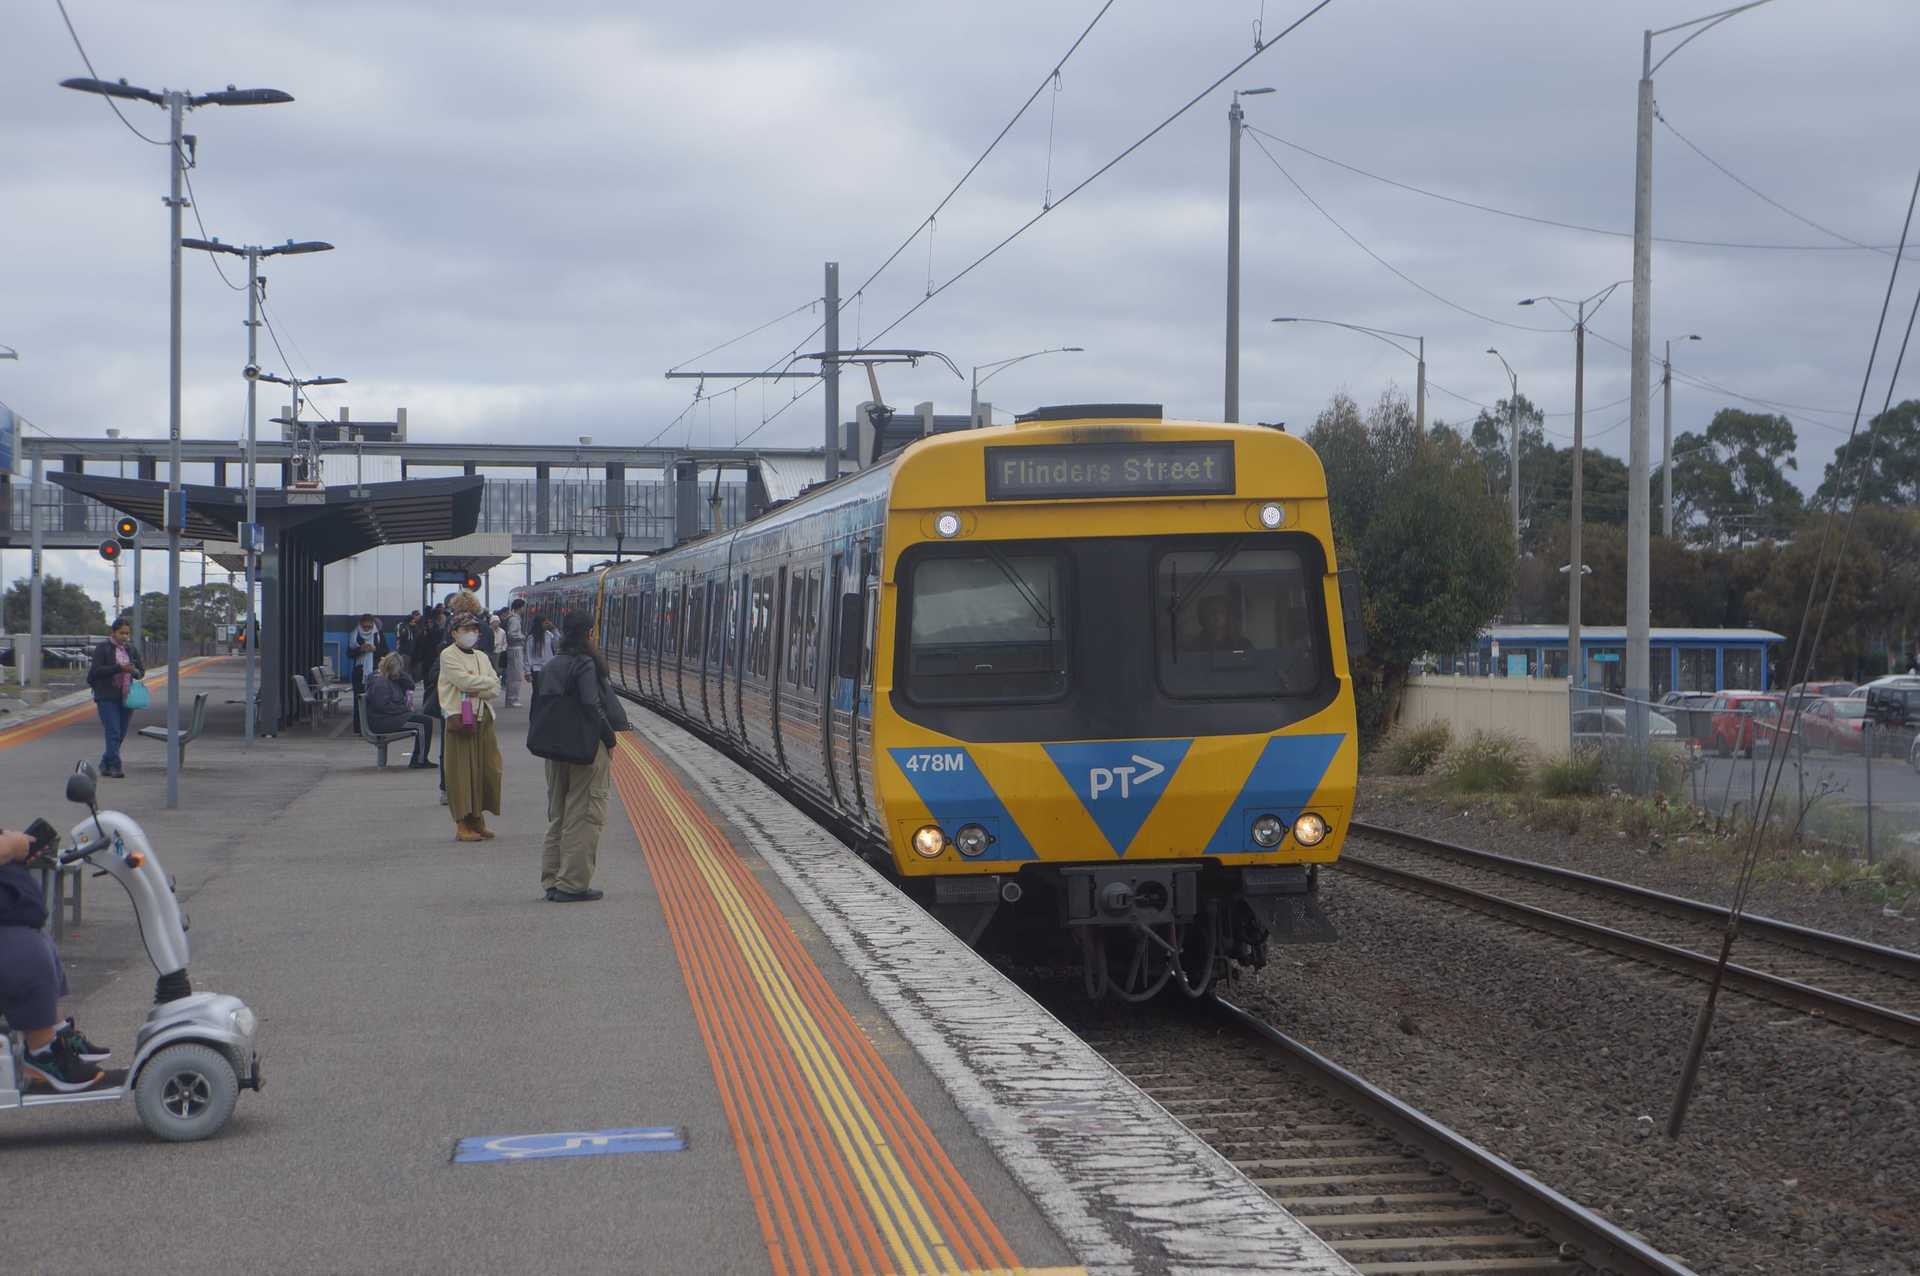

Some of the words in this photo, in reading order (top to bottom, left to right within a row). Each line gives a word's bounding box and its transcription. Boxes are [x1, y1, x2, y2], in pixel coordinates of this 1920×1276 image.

[1002, 460, 1112, 485] Flinders
[1123, 455, 1216, 482] Street
[905, 752, 965, 772] 478M
